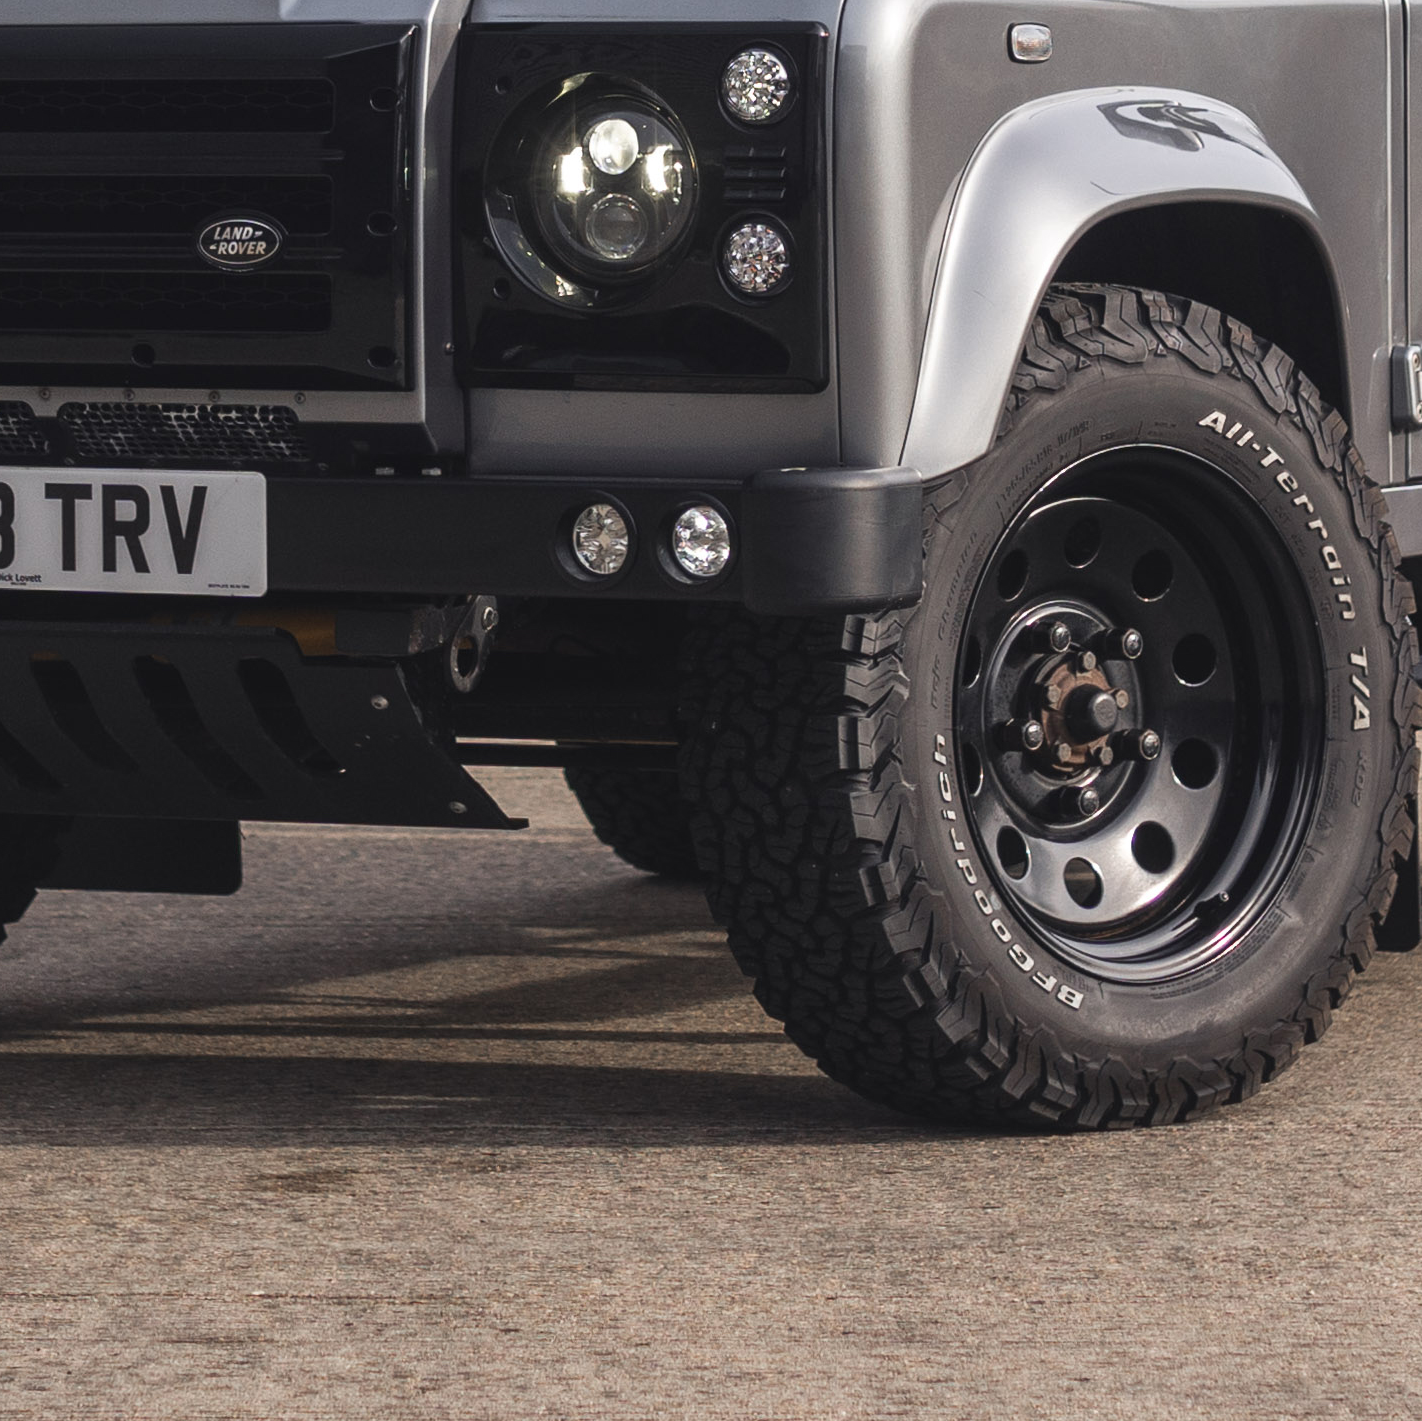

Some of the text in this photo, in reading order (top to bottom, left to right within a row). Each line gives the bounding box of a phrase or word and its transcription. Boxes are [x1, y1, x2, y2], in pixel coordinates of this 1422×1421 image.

[213, 226, 254, 240] LAND
[217, 241, 267, 255] ROVER
[44, 482, 209, 575] TRV
[15, 573, 42, 583] Lovett
[1197, 410, 1356, 620] All-Terrain
[1349, 645, 1371, 731] T/A
[933, 733, 1085, 1011] BFGoodrich
